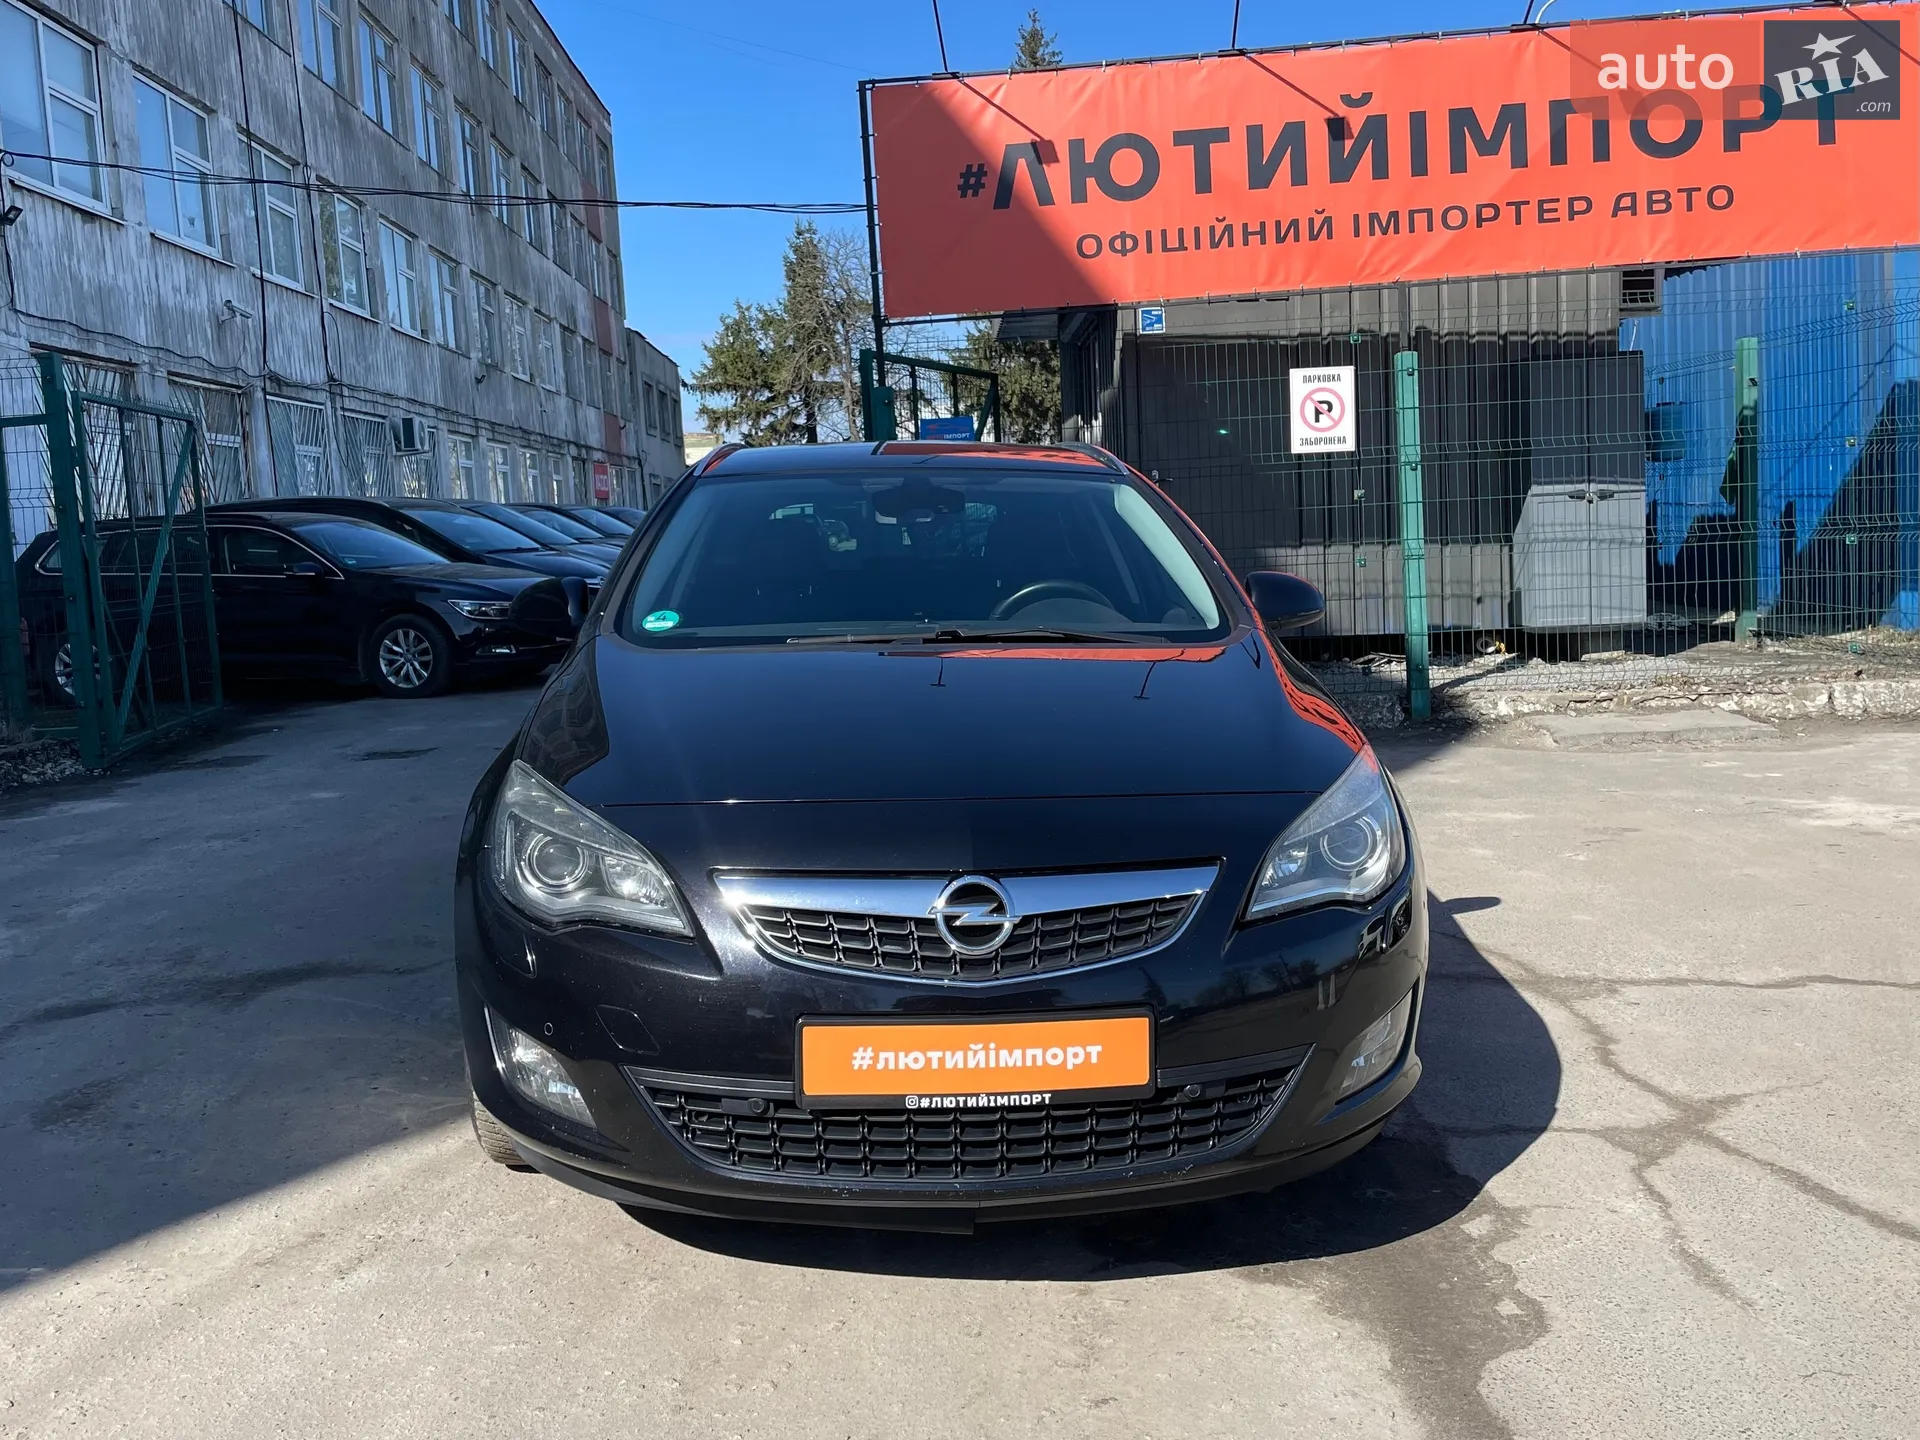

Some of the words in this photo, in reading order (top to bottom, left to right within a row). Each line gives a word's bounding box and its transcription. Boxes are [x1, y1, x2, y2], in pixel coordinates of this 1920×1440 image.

[957, 78, 1855, 210] #ЛЮТИЙІМПОРТ
[1076, 209, 1333, 259] ОФІЦІЙНИЙ
[1353, 196, 1592, 238] ІМПОРТЕР
[1611, 185, 1735, 218] АВТО
[1303, 374, 1341, 384] ПАРКОВКА
[1300, 436, 1347, 446] ЗАБОРОНЕНА
[852, 1043, 1102, 1070] #лютийімпорт
[920, 1094, 1051, 1108] #ЛЮТИЙІМПОРТ
